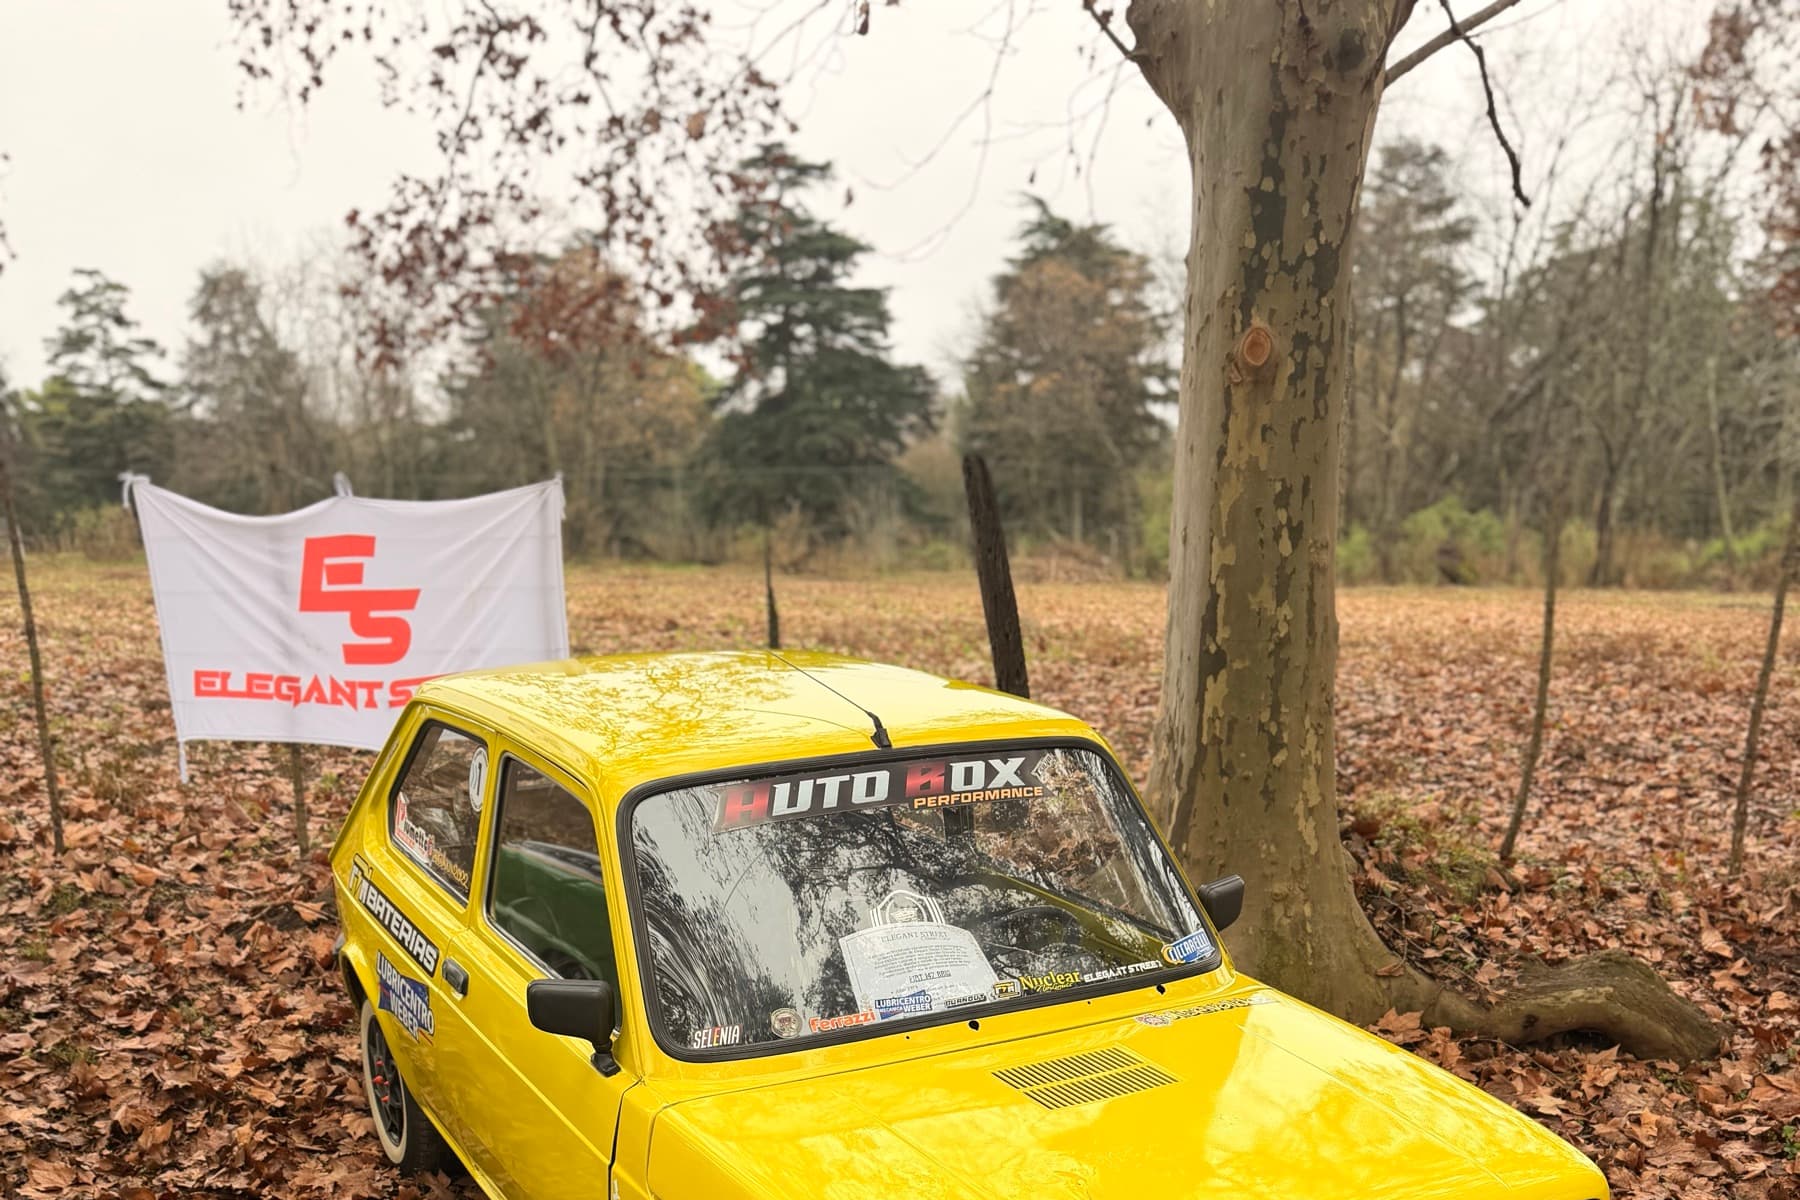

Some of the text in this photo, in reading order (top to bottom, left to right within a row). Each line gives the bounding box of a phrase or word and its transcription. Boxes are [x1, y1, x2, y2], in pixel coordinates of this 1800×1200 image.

[194, 670, 384, 712] ELEGANT
[723, 769, 890, 825] AUTO
[905, 757, 1026, 797] BOX
[913, 786, 1044, 809] PERFORMANCE
[366, 884, 438, 973] BATERIAS
[377, 951, 434, 1034] LUBRICENTRO
[1018, 971, 1081, 991] Nuclear
[875, 994, 931, 1008] LUBRICENTRO
[903, 1003, 931, 1013] WEBER
[389, 989, 419, 1039] WEBER
[809, 1008, 877, 1033] Ferrazzi
[693, 1024, 742, 1049] SELENIA
